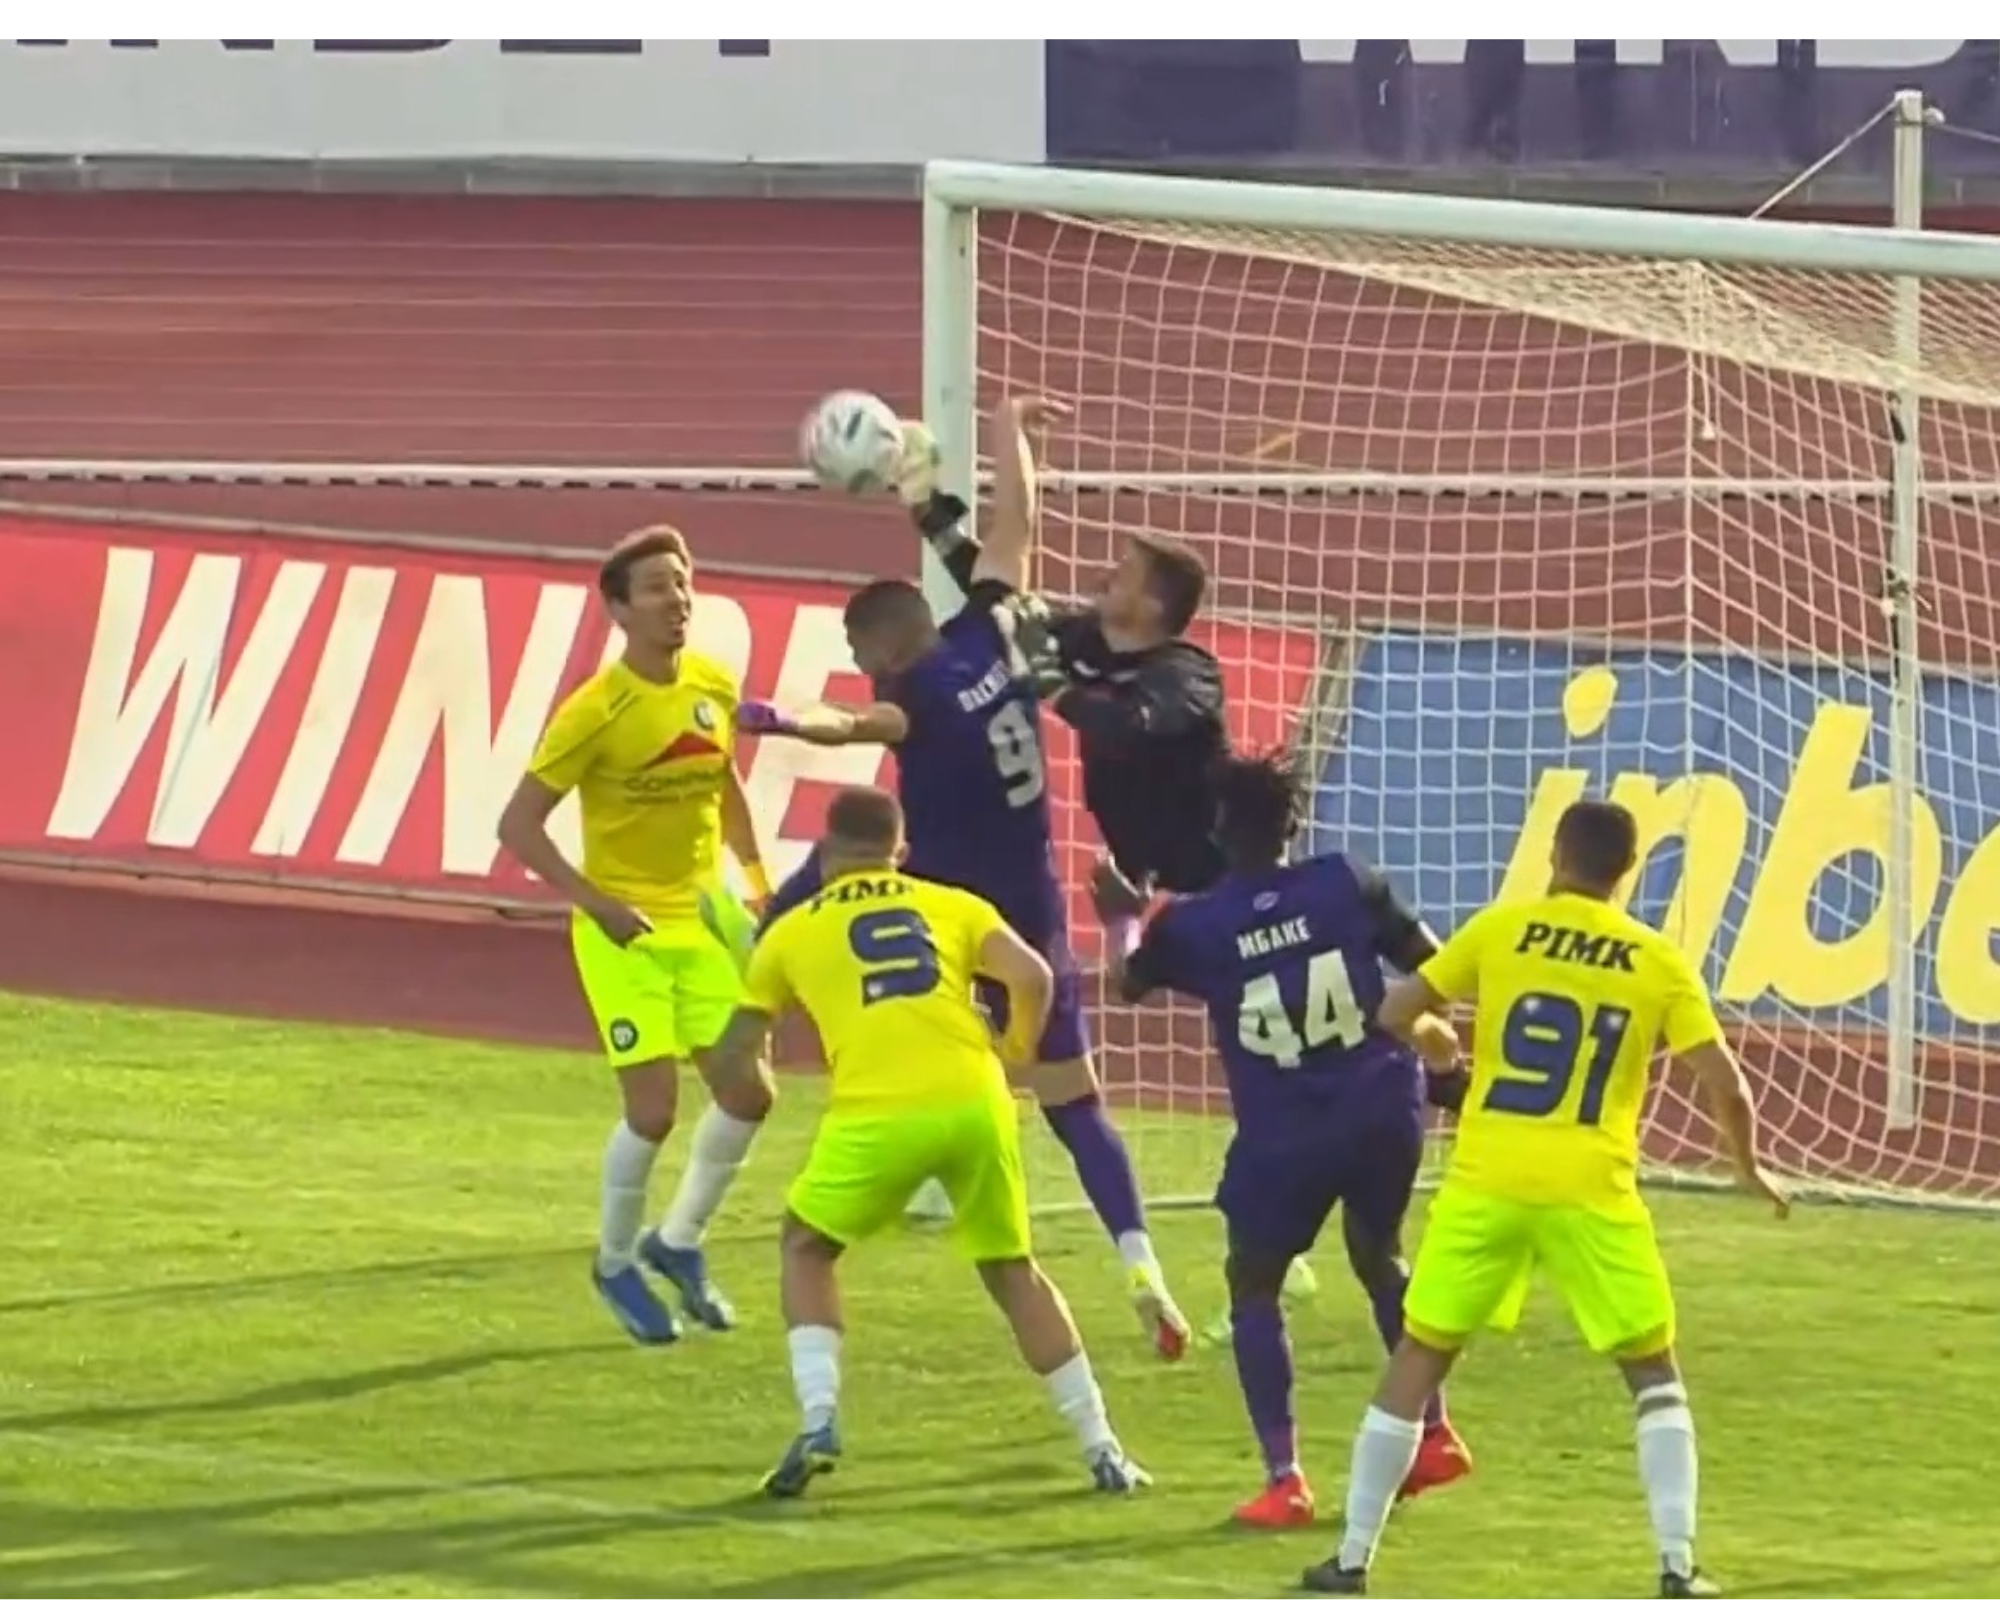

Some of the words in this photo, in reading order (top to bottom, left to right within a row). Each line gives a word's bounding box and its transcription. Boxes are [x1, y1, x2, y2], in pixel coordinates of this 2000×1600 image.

[987, 700, 1044, 809] 9
[1515, 920, 1643, 973] PIMK
[1238, 948, 1367, 1069] 44
[1482, 990, 1632, 1126] 91
